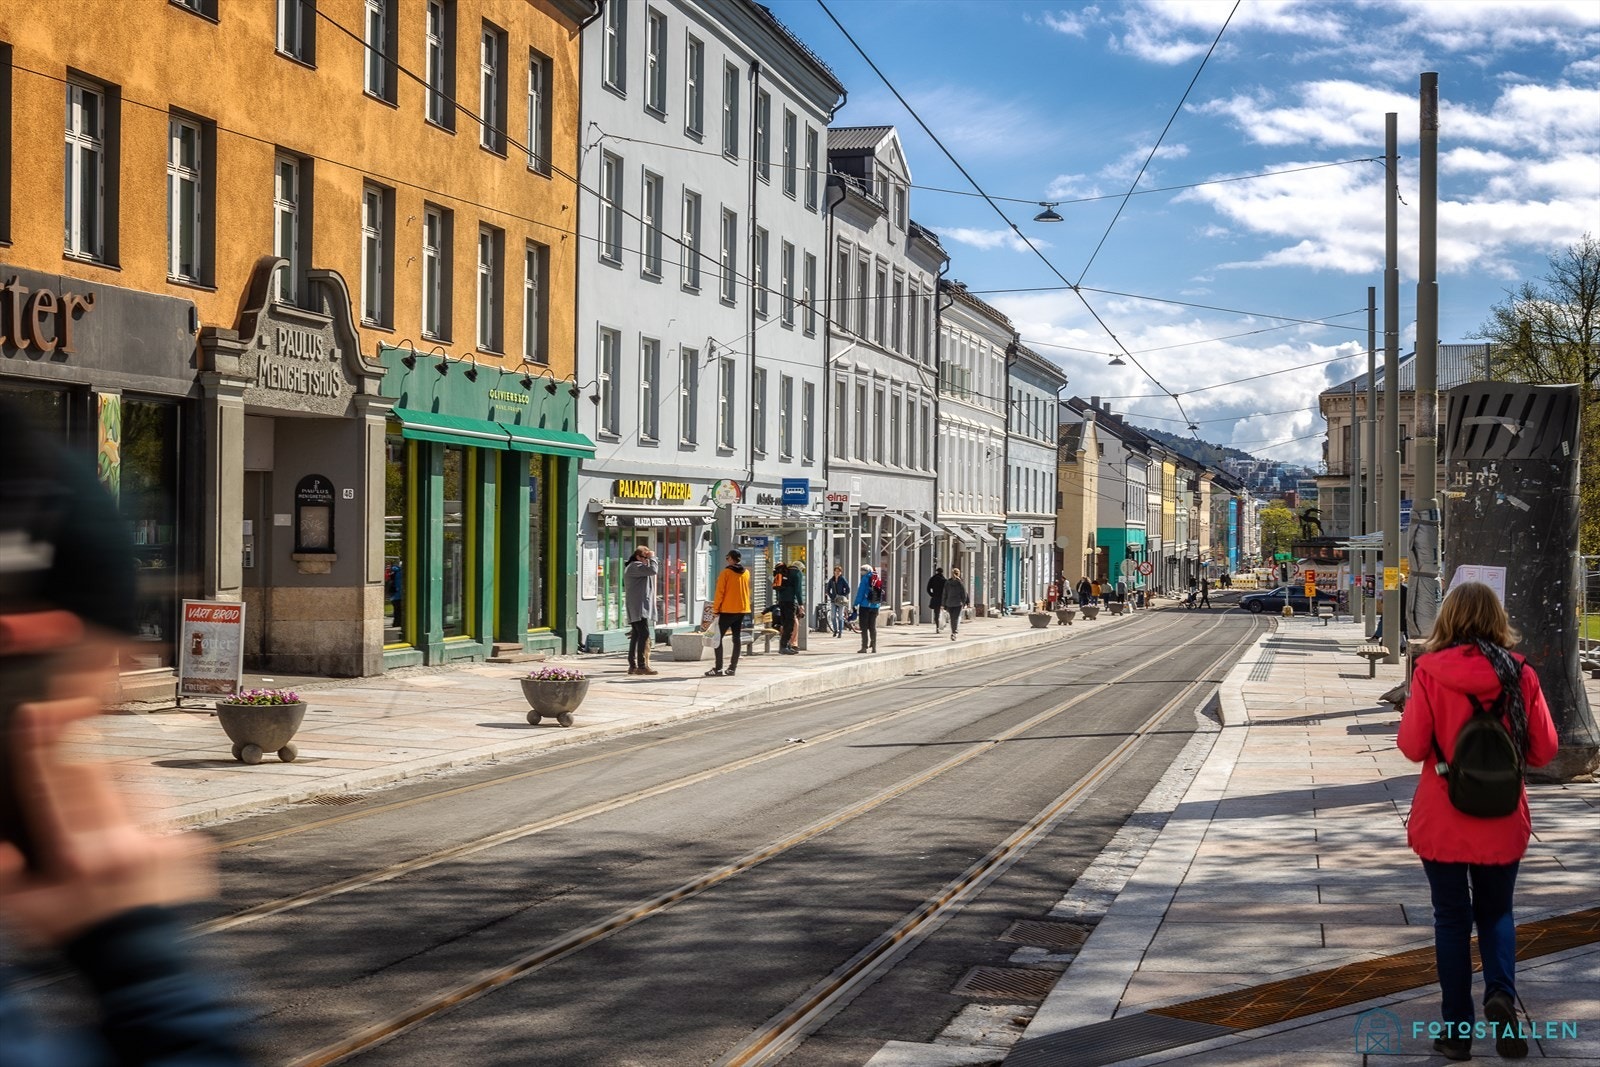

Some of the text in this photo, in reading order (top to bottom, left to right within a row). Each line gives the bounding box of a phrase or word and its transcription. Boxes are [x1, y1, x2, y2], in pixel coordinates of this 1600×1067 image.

[278, 327, 324, 360] PAULUS
[258, 353, 341, 397] MENIGHETSHUS
[619, 479, 692, 500] PALAZZO PIZZERIA
[826, 492, 848, 502] elna
[1306, 571, 1315, 584] E
